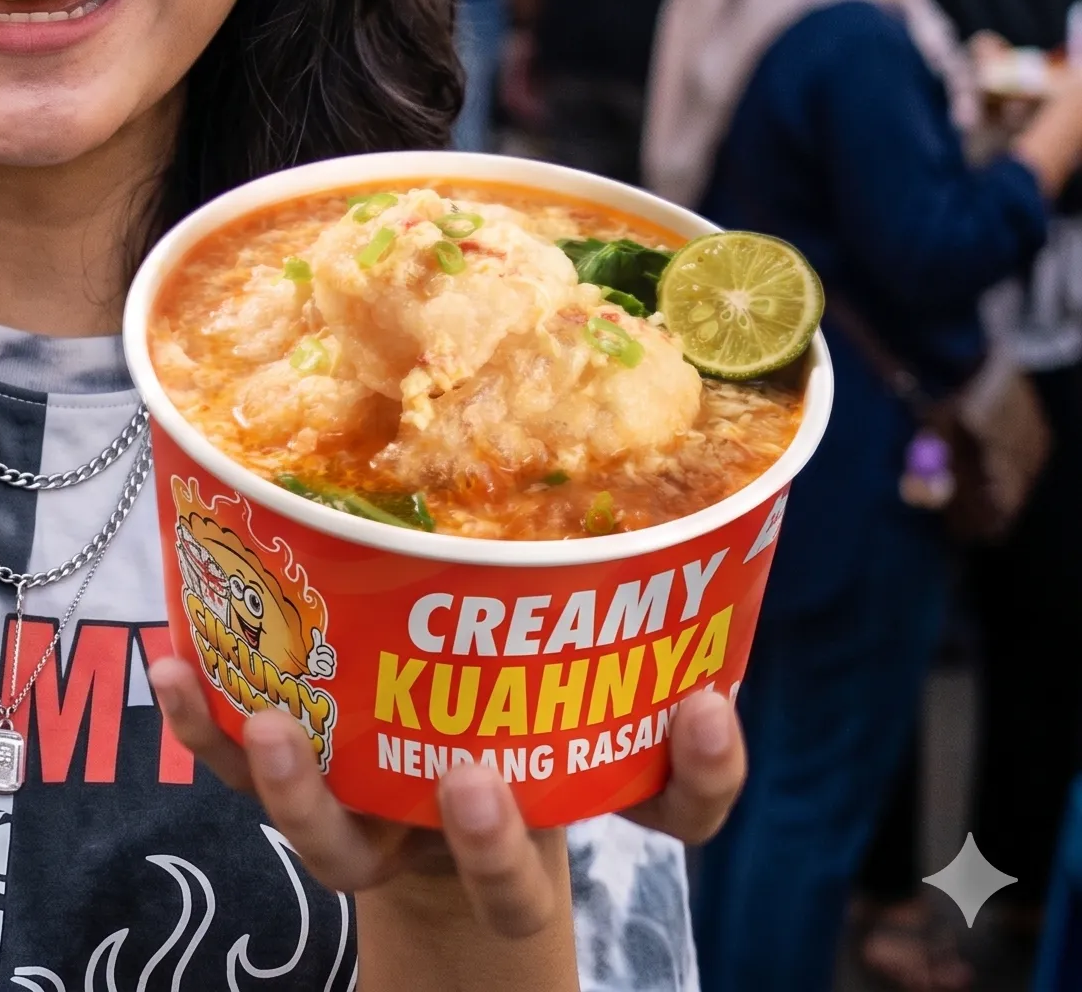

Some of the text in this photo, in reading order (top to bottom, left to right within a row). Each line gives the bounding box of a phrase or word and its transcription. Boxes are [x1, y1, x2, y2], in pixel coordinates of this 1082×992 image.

[186, 593, 331, 736] CIKUMY
[408, 547, 730, 656] CREAMY
[195, 630, 325, 765] YUM
[374, 604, 734, 736] KUAHNYA
[567, 681, 716, 776] RASAN
